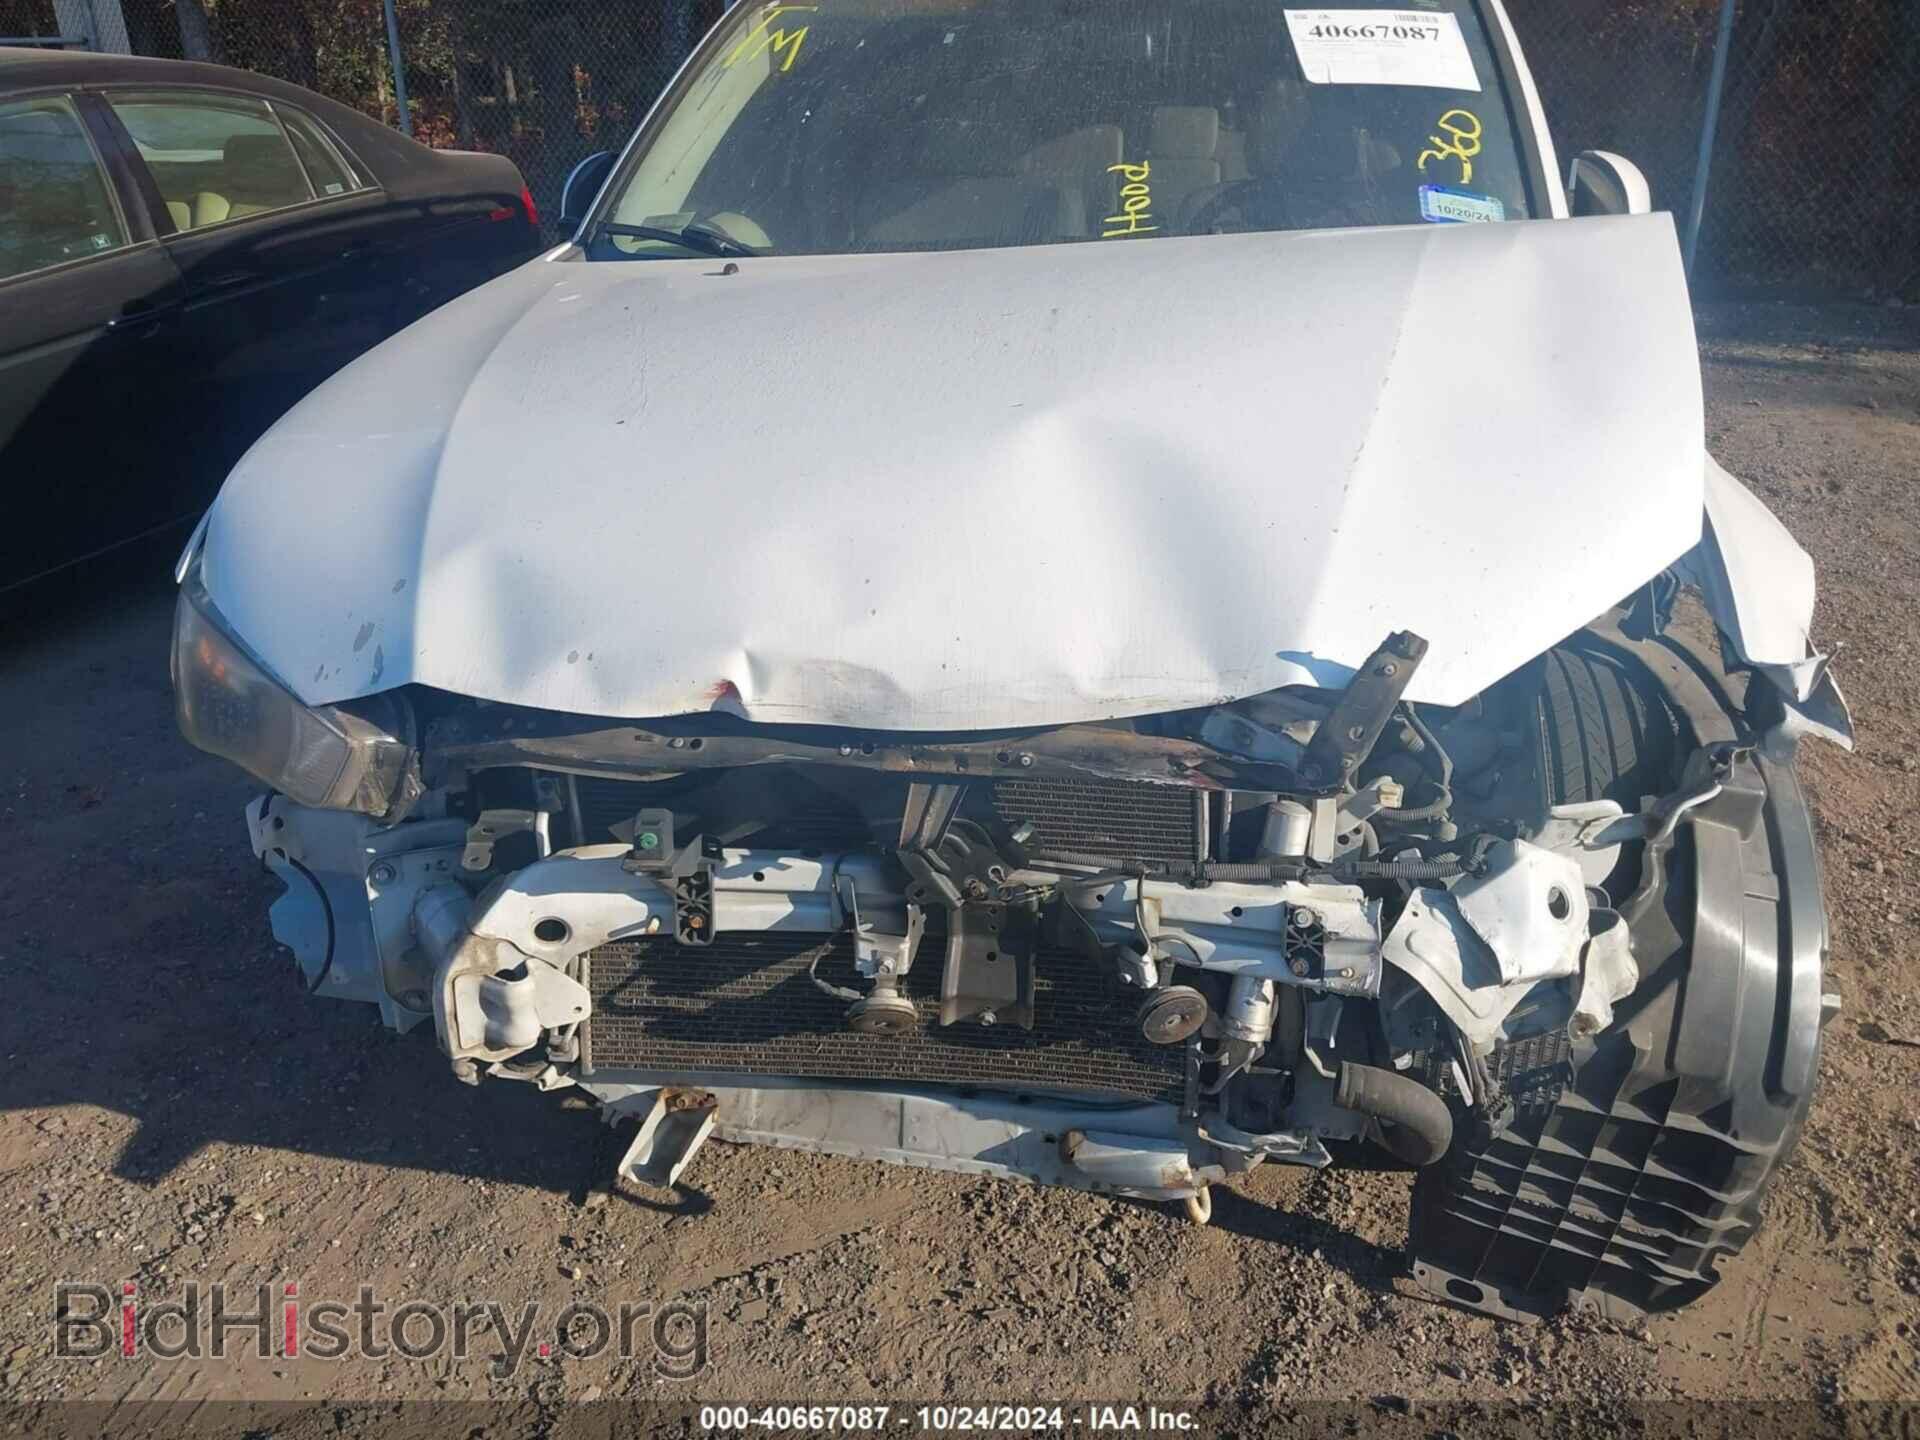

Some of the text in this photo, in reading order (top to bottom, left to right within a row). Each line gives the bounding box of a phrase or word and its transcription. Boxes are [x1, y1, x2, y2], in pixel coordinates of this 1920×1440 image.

[1308, 24, 1439, 42] 40667087
[1101, 159, 1161, 237] Hood
[1436, 203, 1493, 222] 10/20/24
